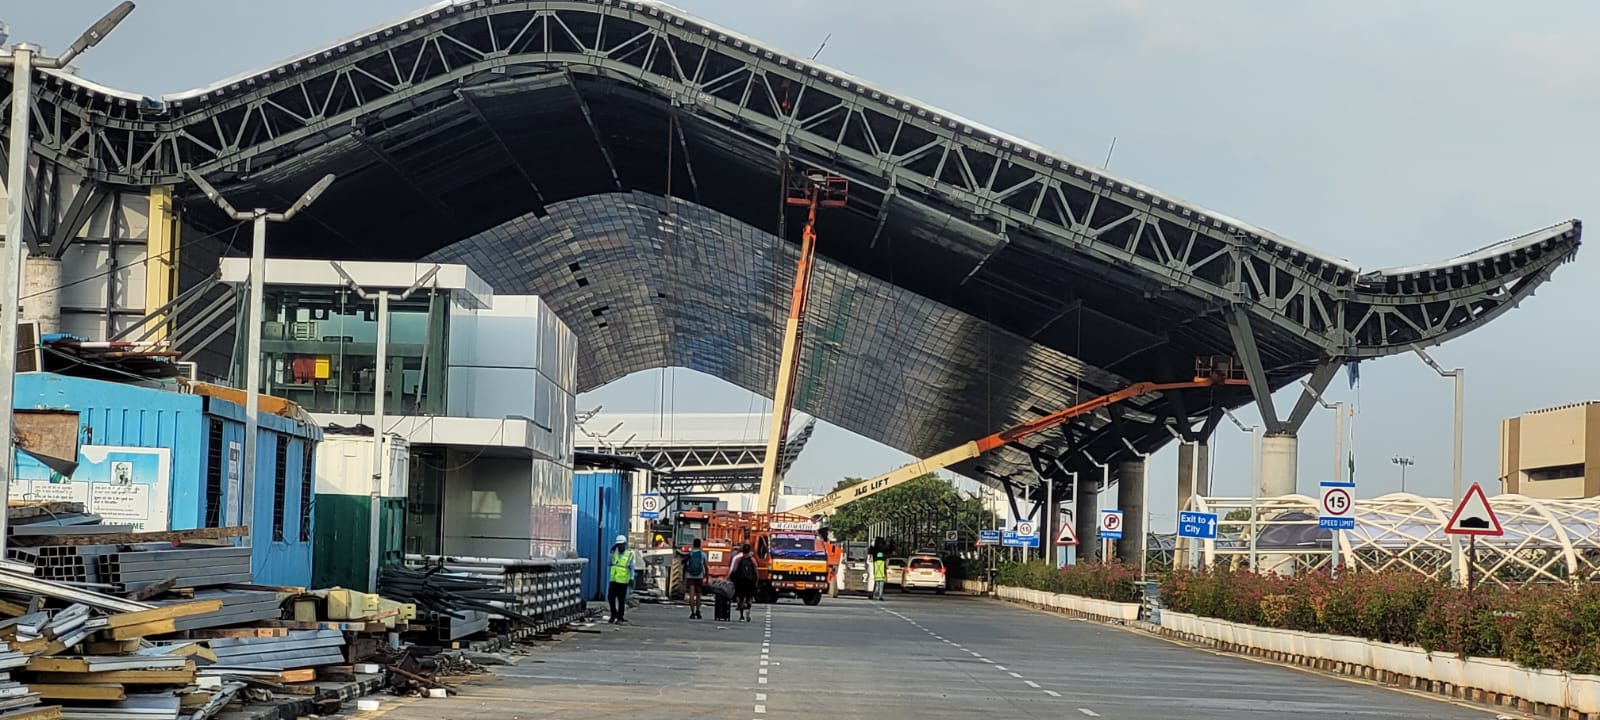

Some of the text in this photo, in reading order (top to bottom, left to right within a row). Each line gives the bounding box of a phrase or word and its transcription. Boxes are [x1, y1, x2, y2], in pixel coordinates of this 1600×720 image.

[854, 477, 889, 497] JLG LIFT
[1329, 496, 1345, 508] 15
[1181, 514, 1206, 524] Exit to
[1320, 519, 1338, 527] SPEED
[1185, 525, 1200, 534] City
